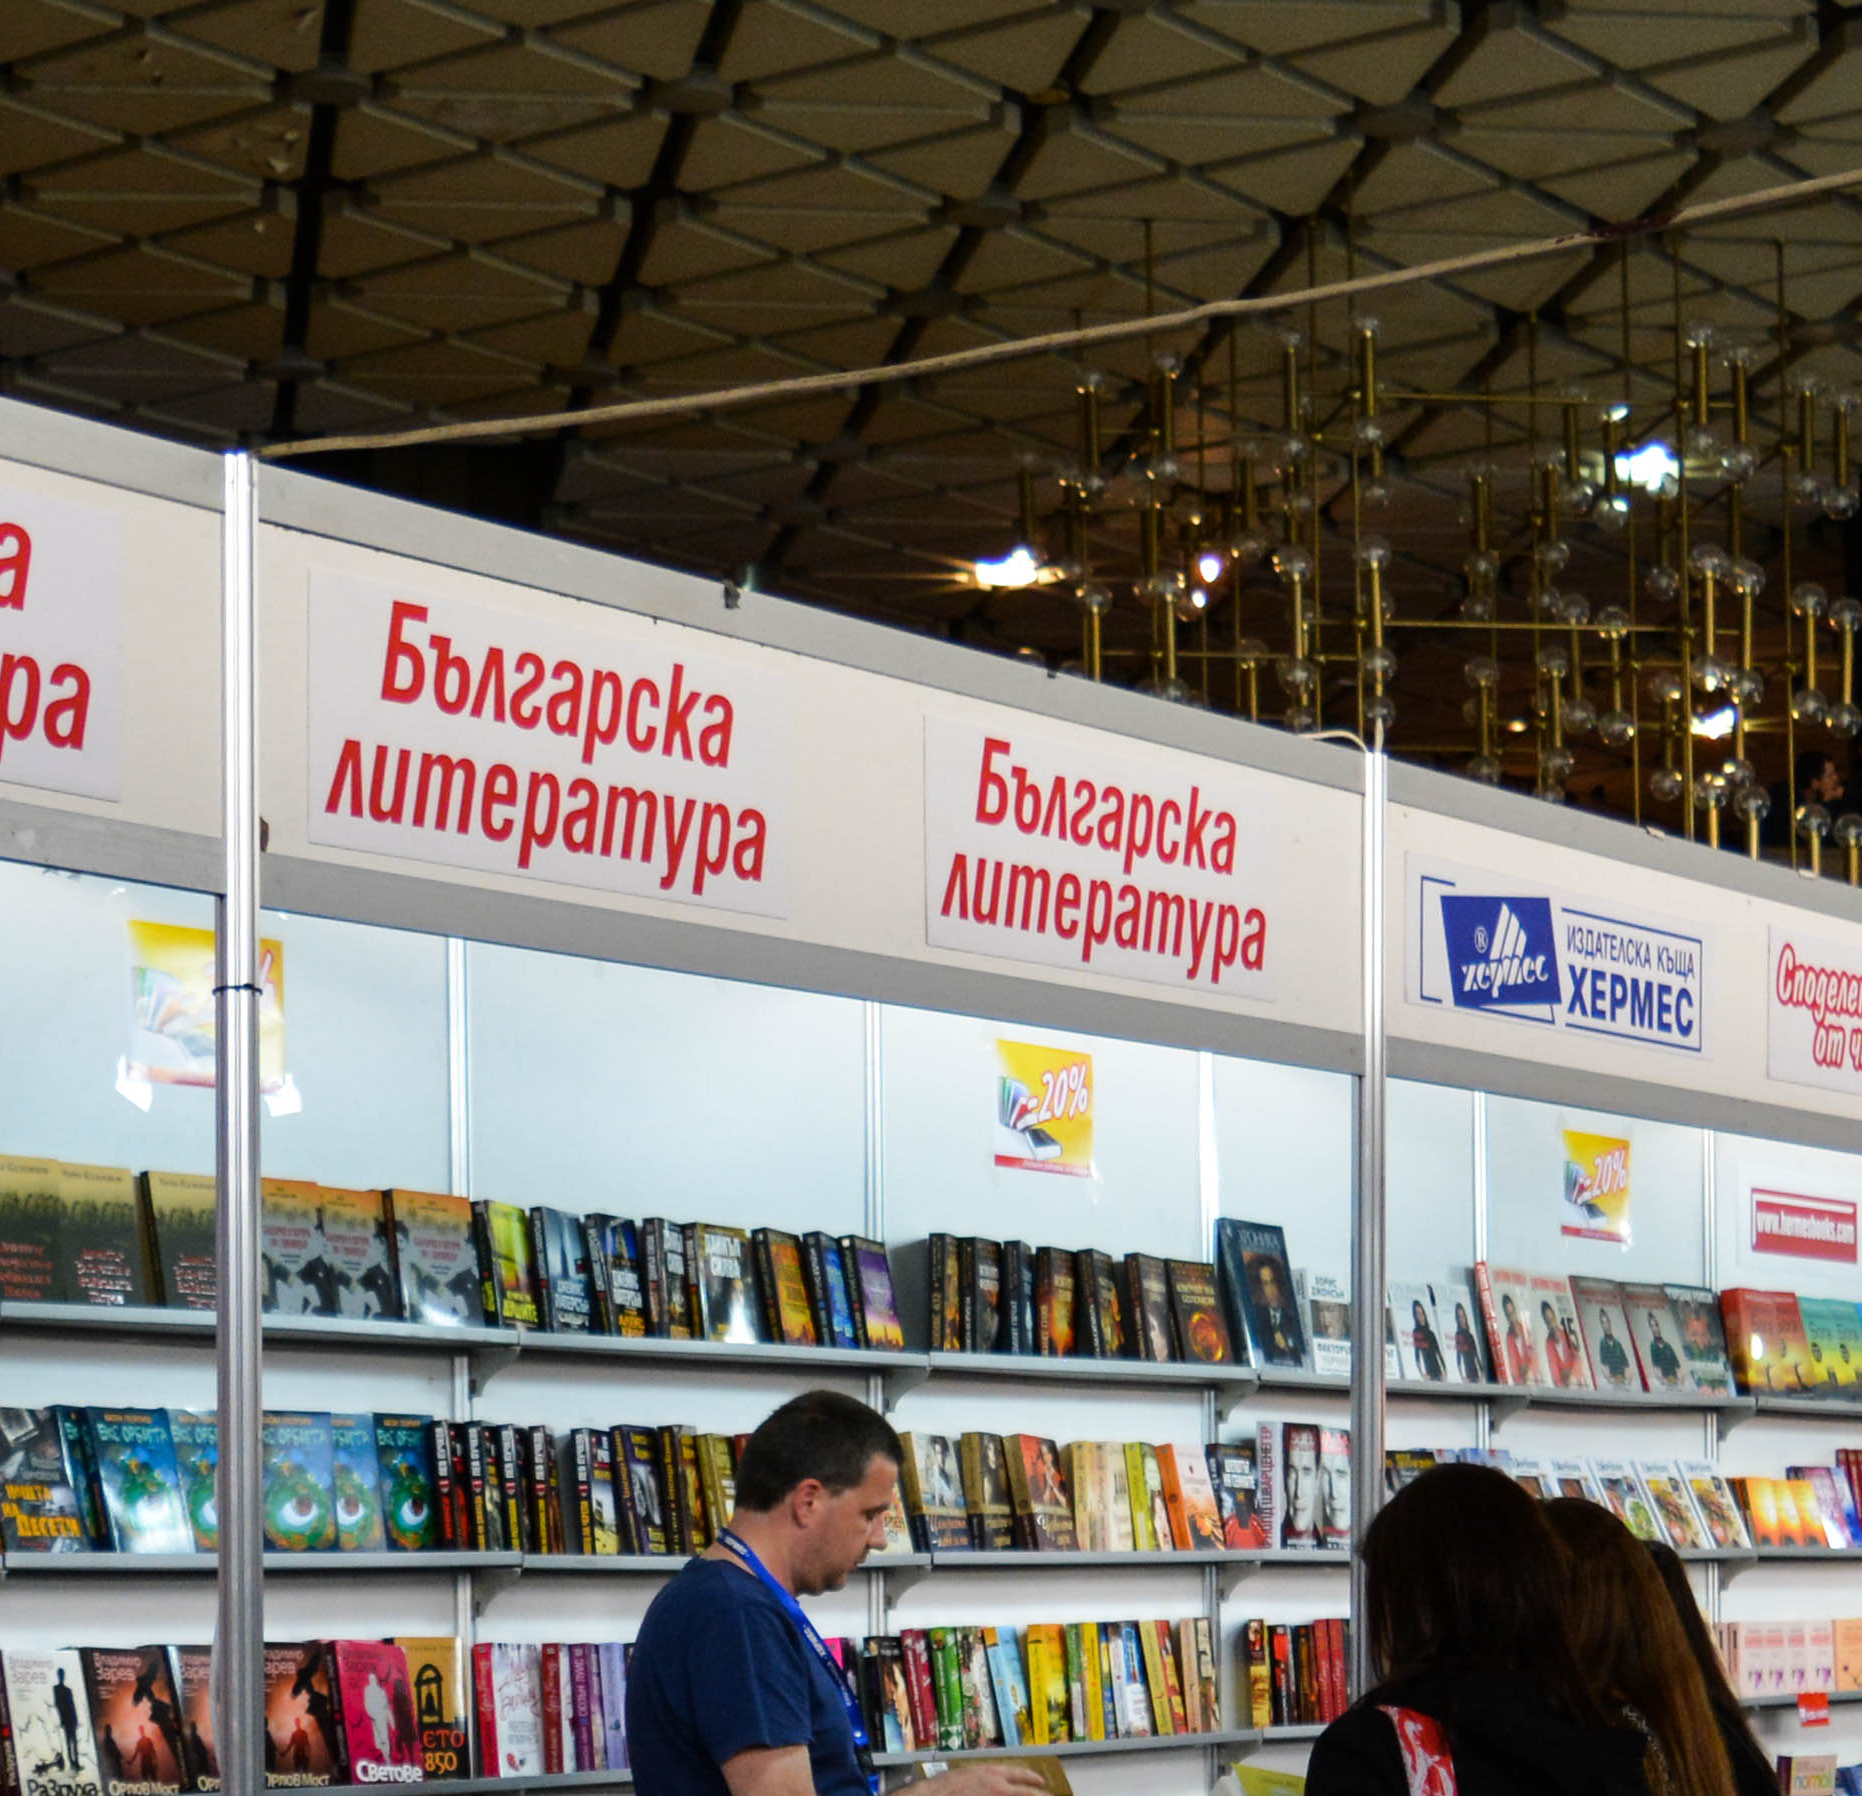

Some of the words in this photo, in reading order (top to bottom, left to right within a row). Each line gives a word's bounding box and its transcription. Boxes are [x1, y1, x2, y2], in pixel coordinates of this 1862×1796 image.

[381, 601, 735, 769] Българска
[326, 739, 766, 895] литература
[975, 739, 1237, 875] Българска
[941, 853, 1266, 984] литература
[1566, 925, 1651, 969] ИЗДАТЕЛСКА
[1657, 946, 1695, 985] КЪЩА
[1462, 955, 1549, 999] хермес
[1567, 963, 1694, 1038] ХЕРМЕС
[1812, 1023, 1844, 1069] от
